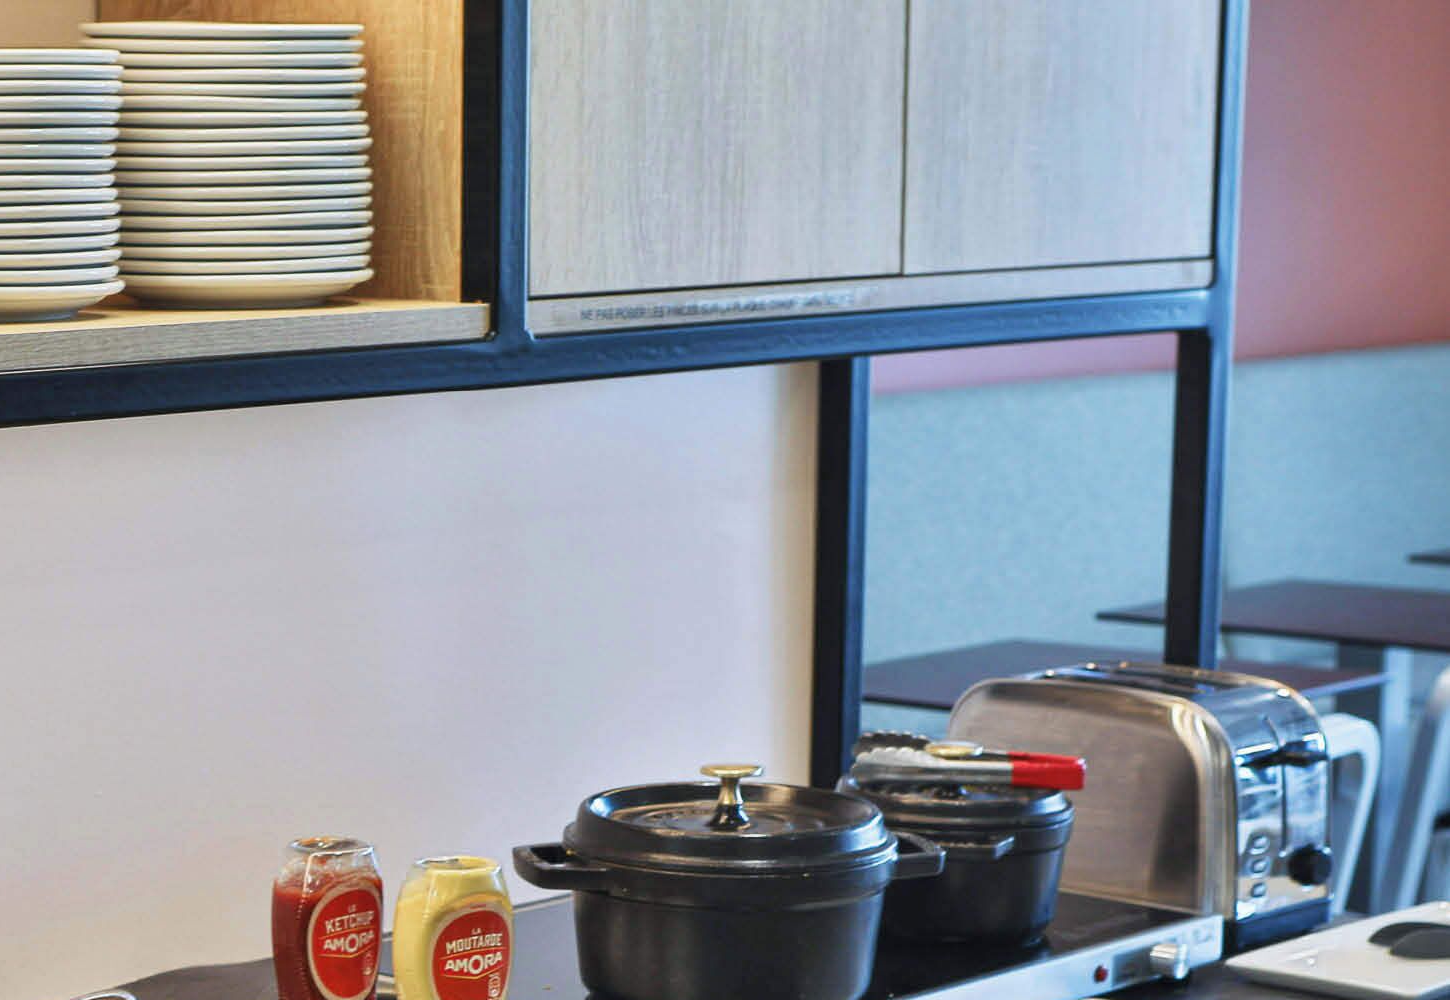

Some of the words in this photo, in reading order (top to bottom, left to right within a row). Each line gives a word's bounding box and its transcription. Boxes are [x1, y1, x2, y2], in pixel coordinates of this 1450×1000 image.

[323, 930, 374, 953] AMORA
[445, 933, 503, 954] MOUTARDE
[444, 951, 503, 974] AMORA
